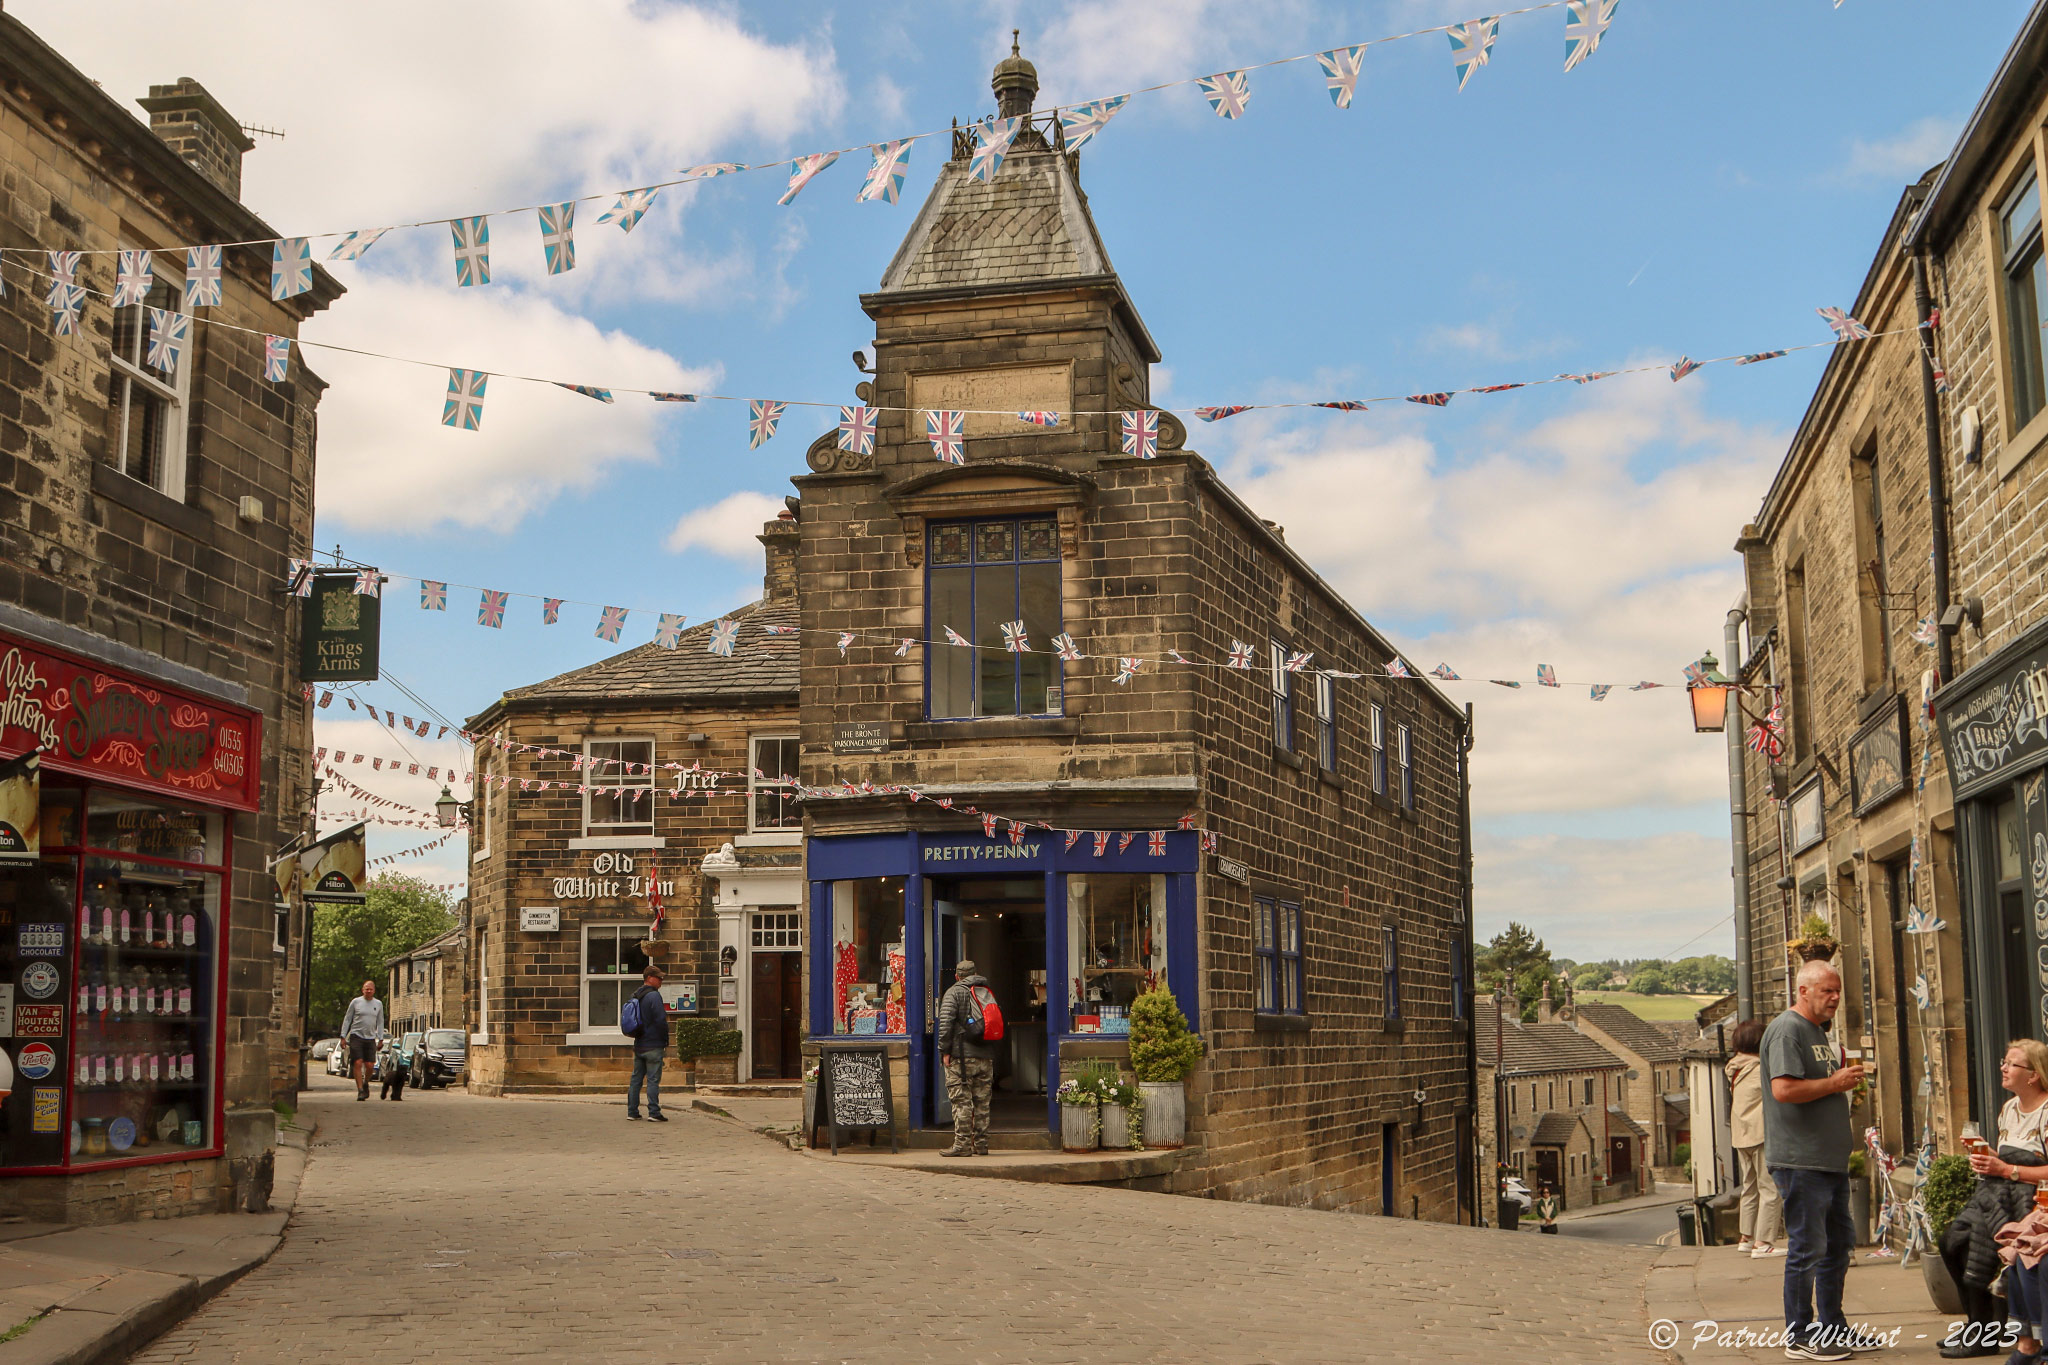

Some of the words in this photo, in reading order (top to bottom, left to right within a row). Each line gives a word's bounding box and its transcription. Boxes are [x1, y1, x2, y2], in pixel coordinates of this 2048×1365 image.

[317, 640, 363, 659] Kings
[318, 656, 361, 671] Arms
[219, 727, 242, 751] 01535
[834, 739, 865, 748] PARSONAGE
[866, 738, 889, 746] MUSEUM
[841, 730, 853, 739] THE
[213, 750, 244, 777] 640303
[672, 768, 720, 791] Free
[117, 810, 137, 829] All
[593, 853, 634, 874] Old
[1220, 859, 1247, 881] CHANGEGATE
[553, 876, 620, 901] White
[626, 876, 675, 898] Lin
[20, 948, 61, 956] CHOCOLATE
[18, 1006, 39, 1017] VAN
[26, 1025, 59, 1033] COCOA
[35, 1101, 58, 1112] COUGH
[41, 1107, 58, 1116] CURE
